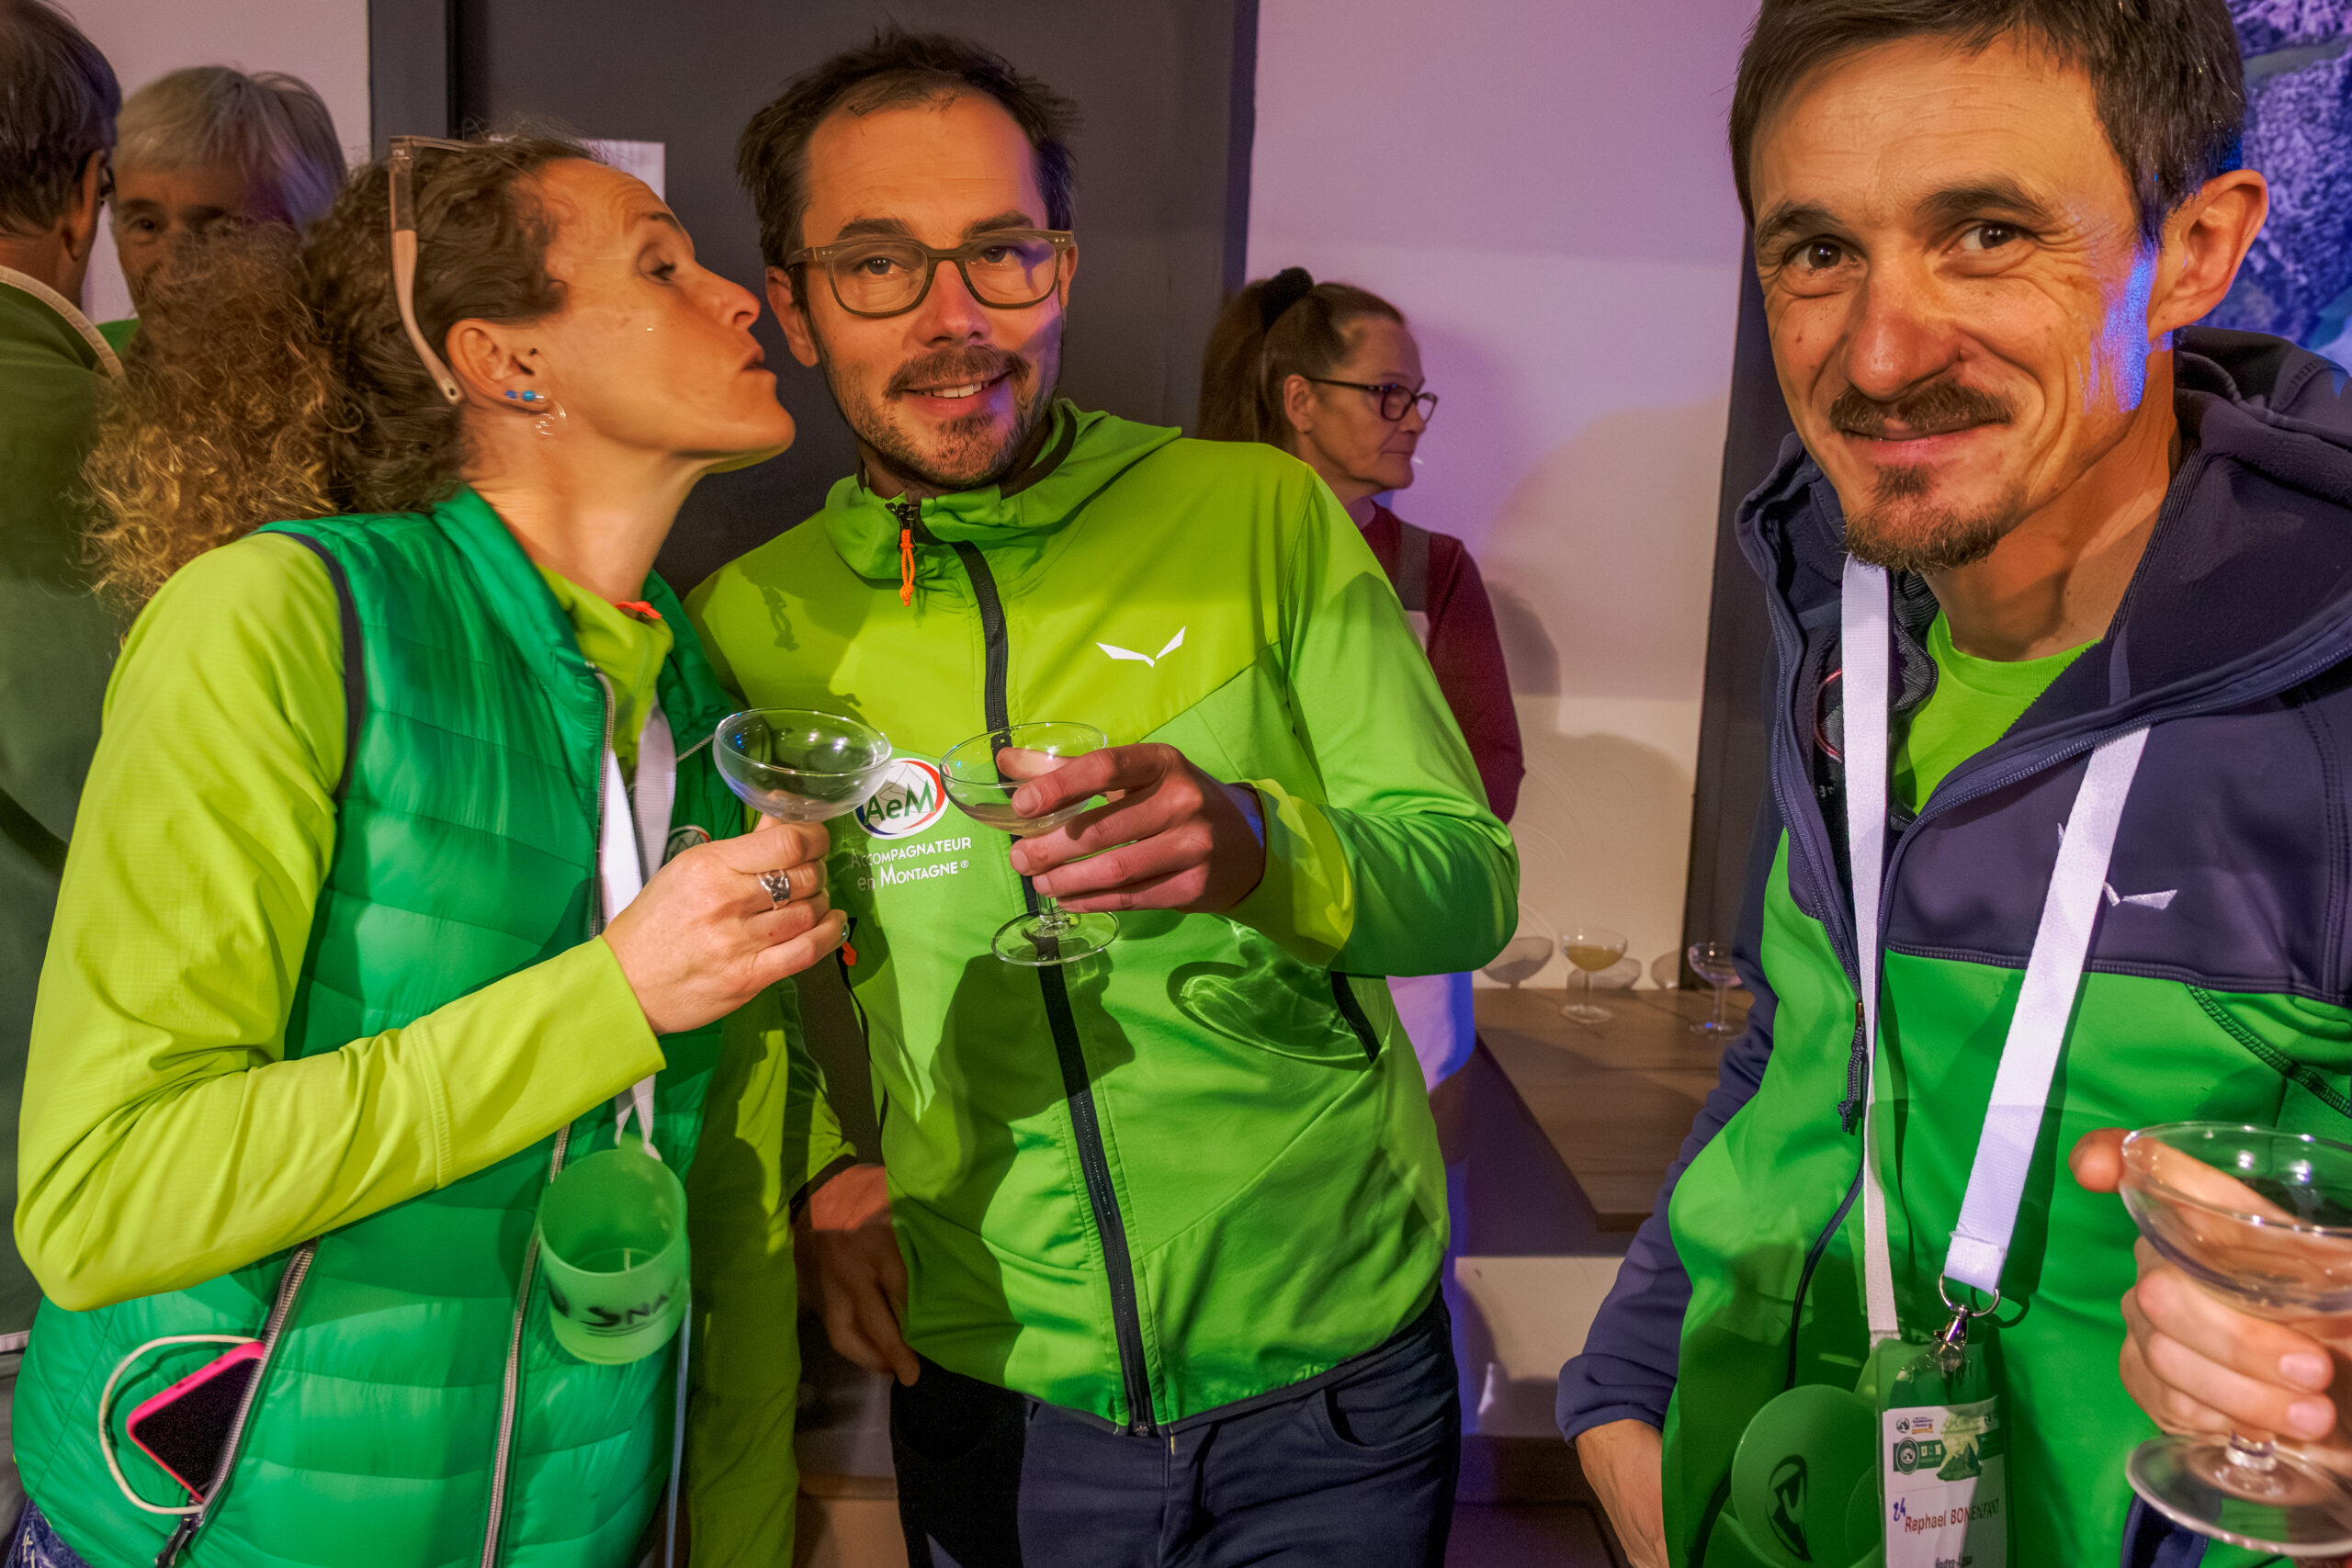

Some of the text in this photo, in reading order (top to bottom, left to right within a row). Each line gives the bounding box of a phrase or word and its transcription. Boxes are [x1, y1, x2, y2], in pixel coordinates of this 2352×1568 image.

[864, 781, 935, 825] AeM
[851, 837, 971, 868] ACCOMPAGNATEUR
[857, 875, 876, 891] en
[1905, 1510, 1947, 1534] Raphael
